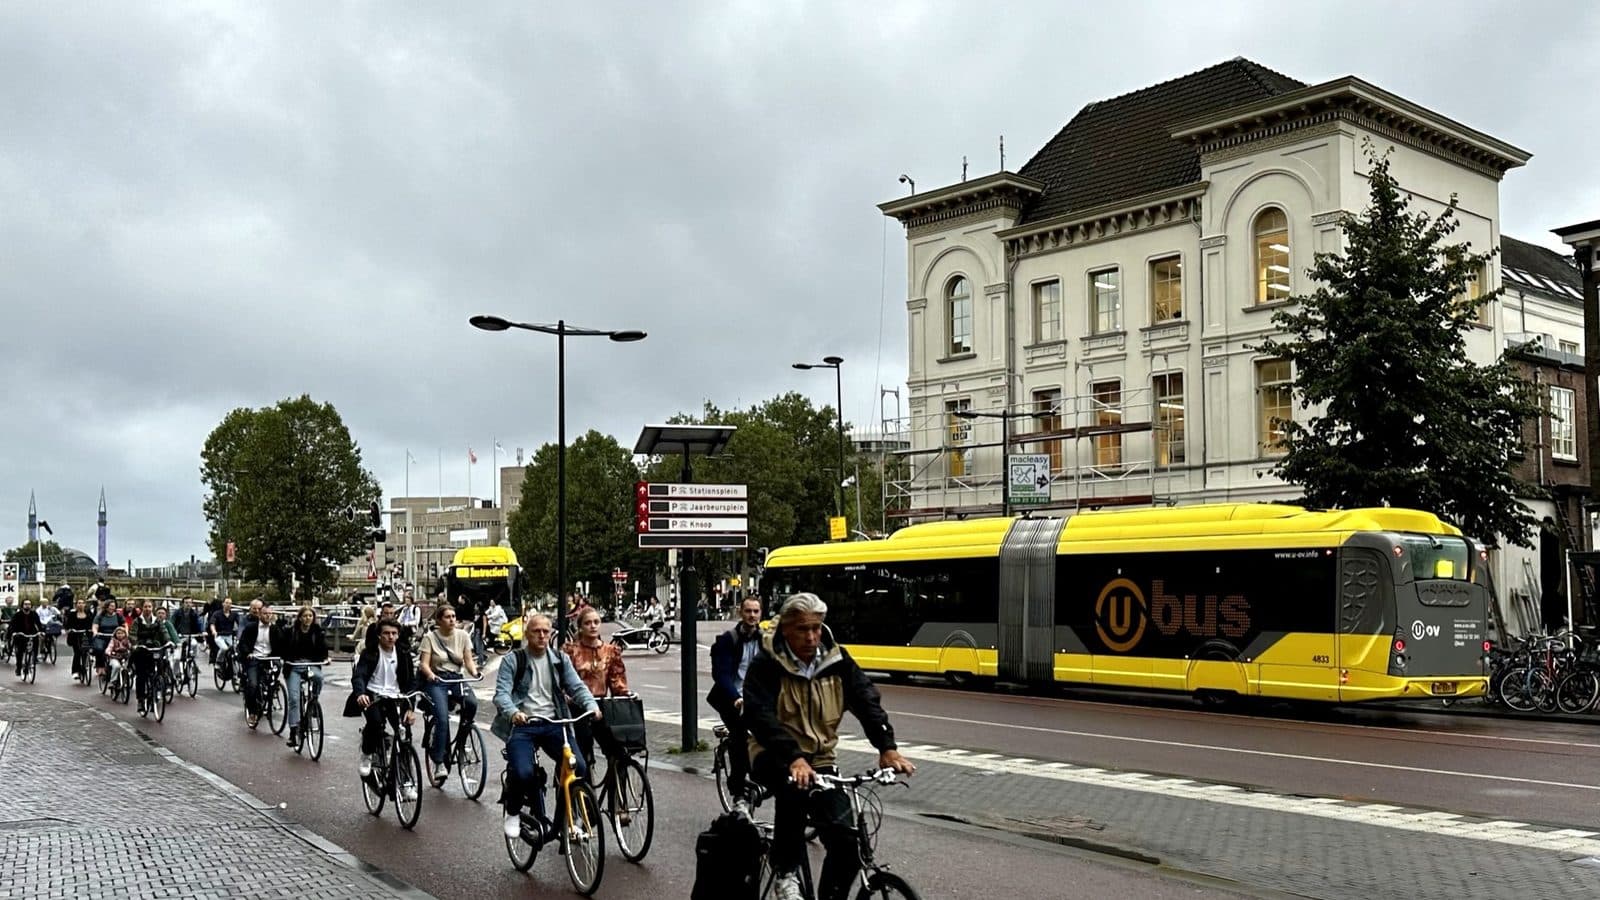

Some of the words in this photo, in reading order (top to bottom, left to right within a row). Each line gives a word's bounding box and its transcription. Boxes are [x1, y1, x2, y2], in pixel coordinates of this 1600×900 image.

[671, 486, 677, 494] P
[689, 486, 738, 495] Stationsplein
[690, 503, 744, 512] Jaarbeursplein
[672, 520, 677, 528] P
[690, 520, 712, 529] Knoop
[1152, 580, 1251, 637] bus
[1312, 655, 1329, 663] 4833
